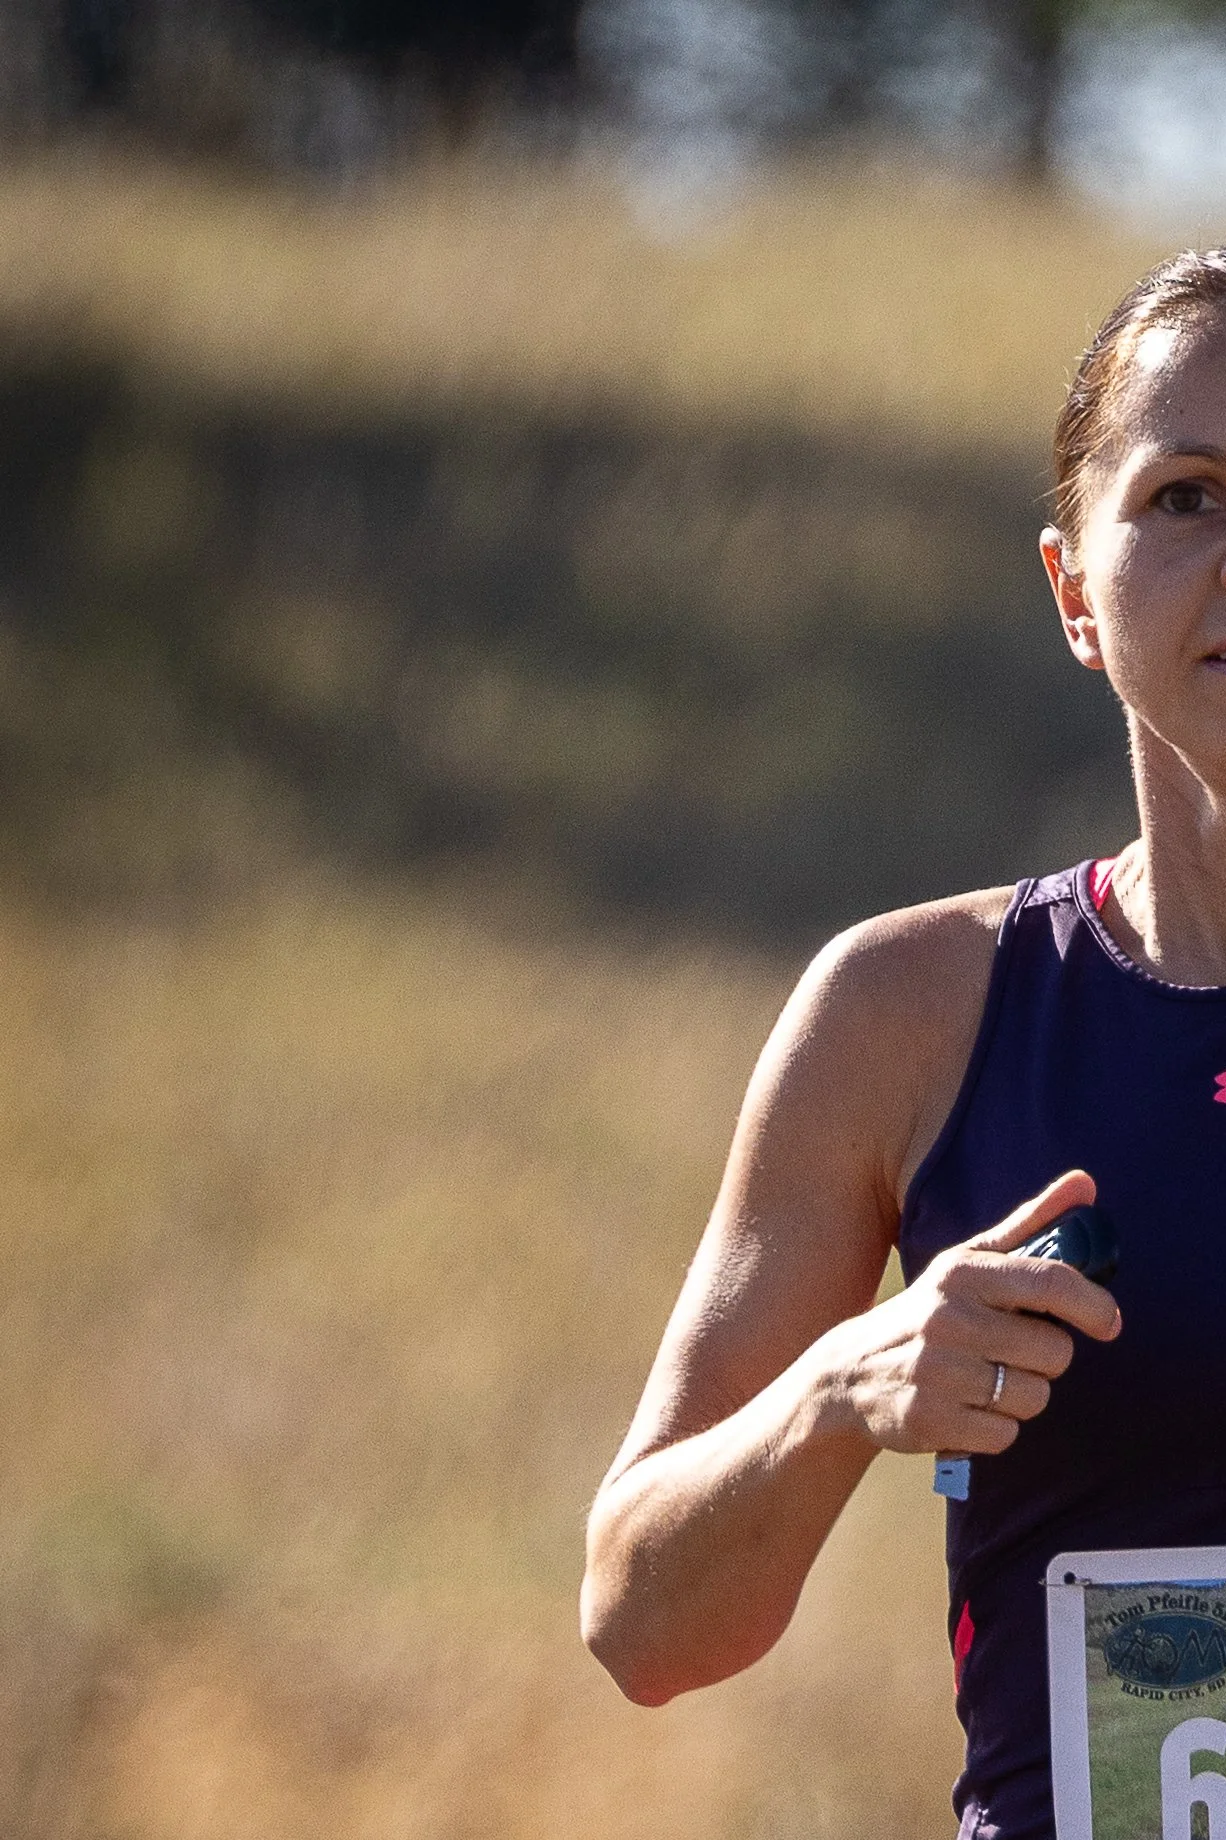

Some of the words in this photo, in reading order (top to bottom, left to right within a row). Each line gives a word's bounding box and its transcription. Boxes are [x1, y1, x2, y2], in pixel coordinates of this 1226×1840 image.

[1104, 1602, 1145, 1627] Tom
[1148, 1592, 1208, 1611] Pfeifle
[1121, 1681, 1165, 1701] RAPID
[1168, 1686, 1205, 1701] CITY,
